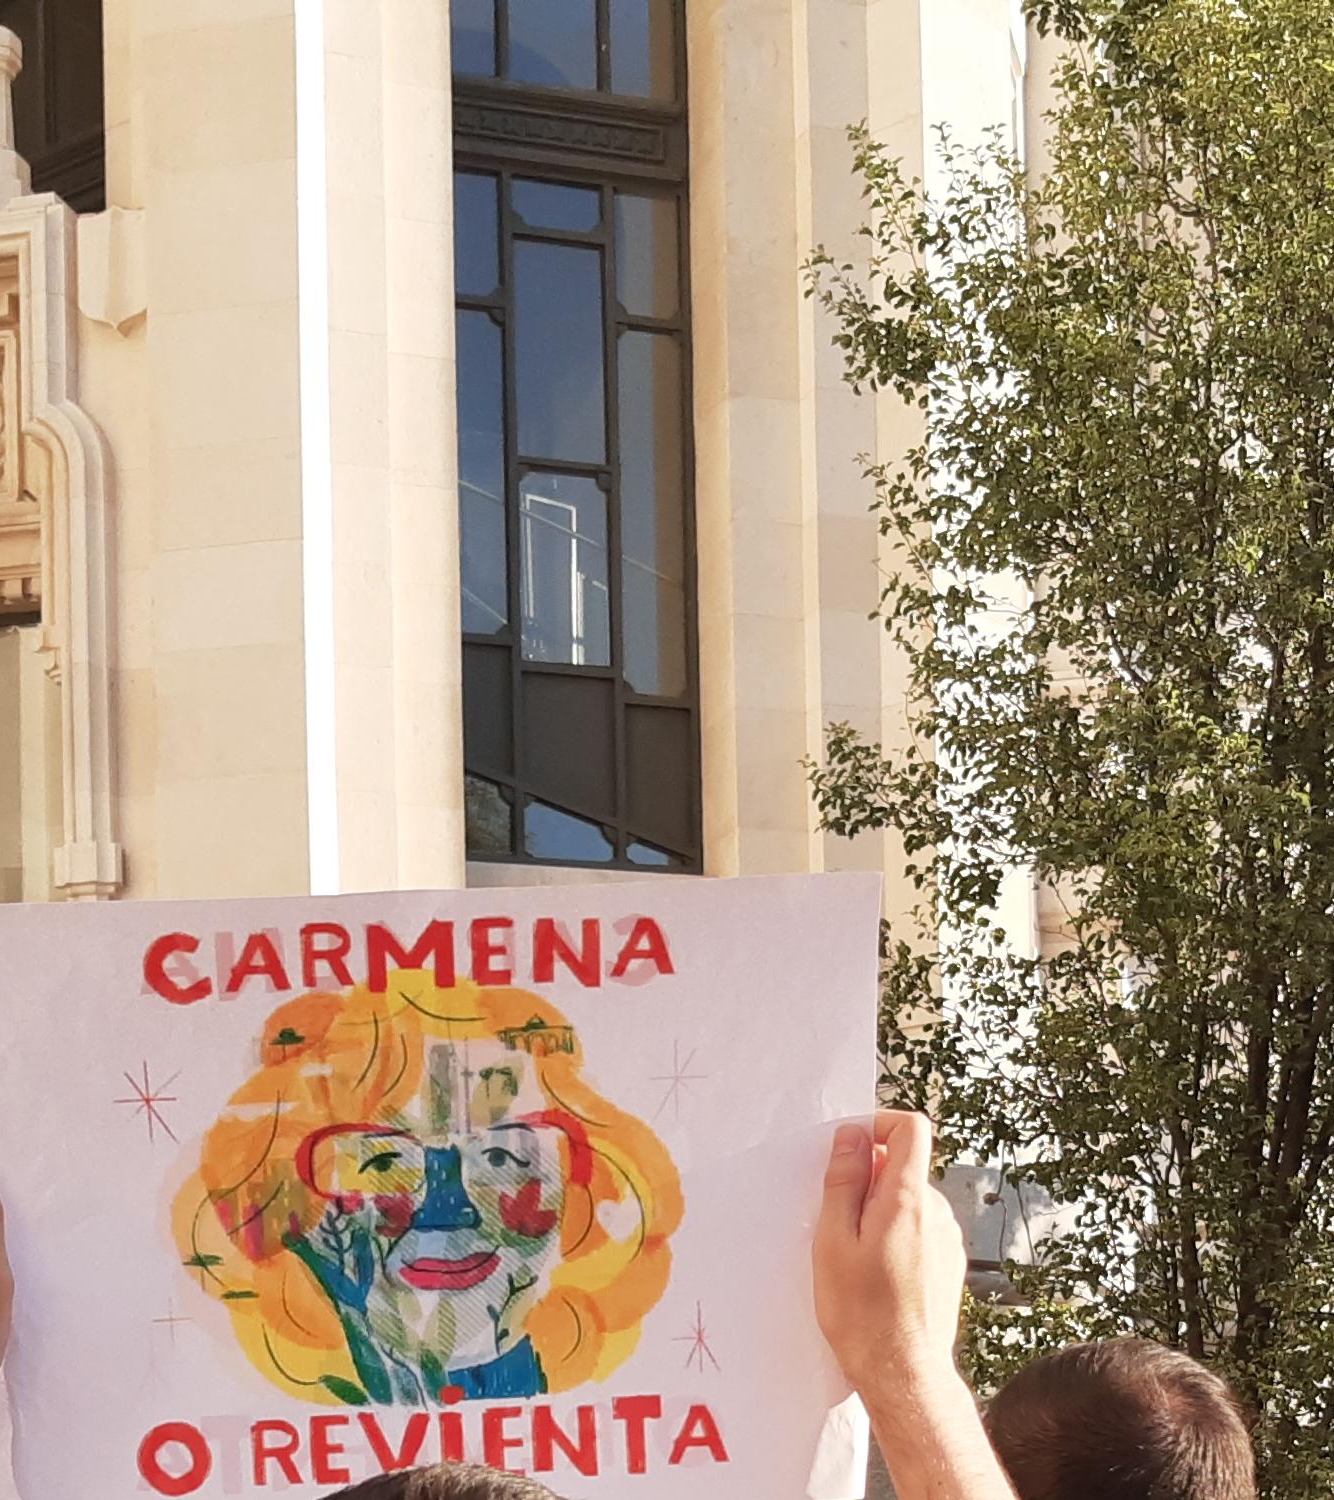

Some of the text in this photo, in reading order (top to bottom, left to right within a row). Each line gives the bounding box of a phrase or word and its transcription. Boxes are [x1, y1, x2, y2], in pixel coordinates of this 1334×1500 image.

[143, 916, 675, 1005] CARMENA
[137, 1386, 730, 1497] O REVIENTA
